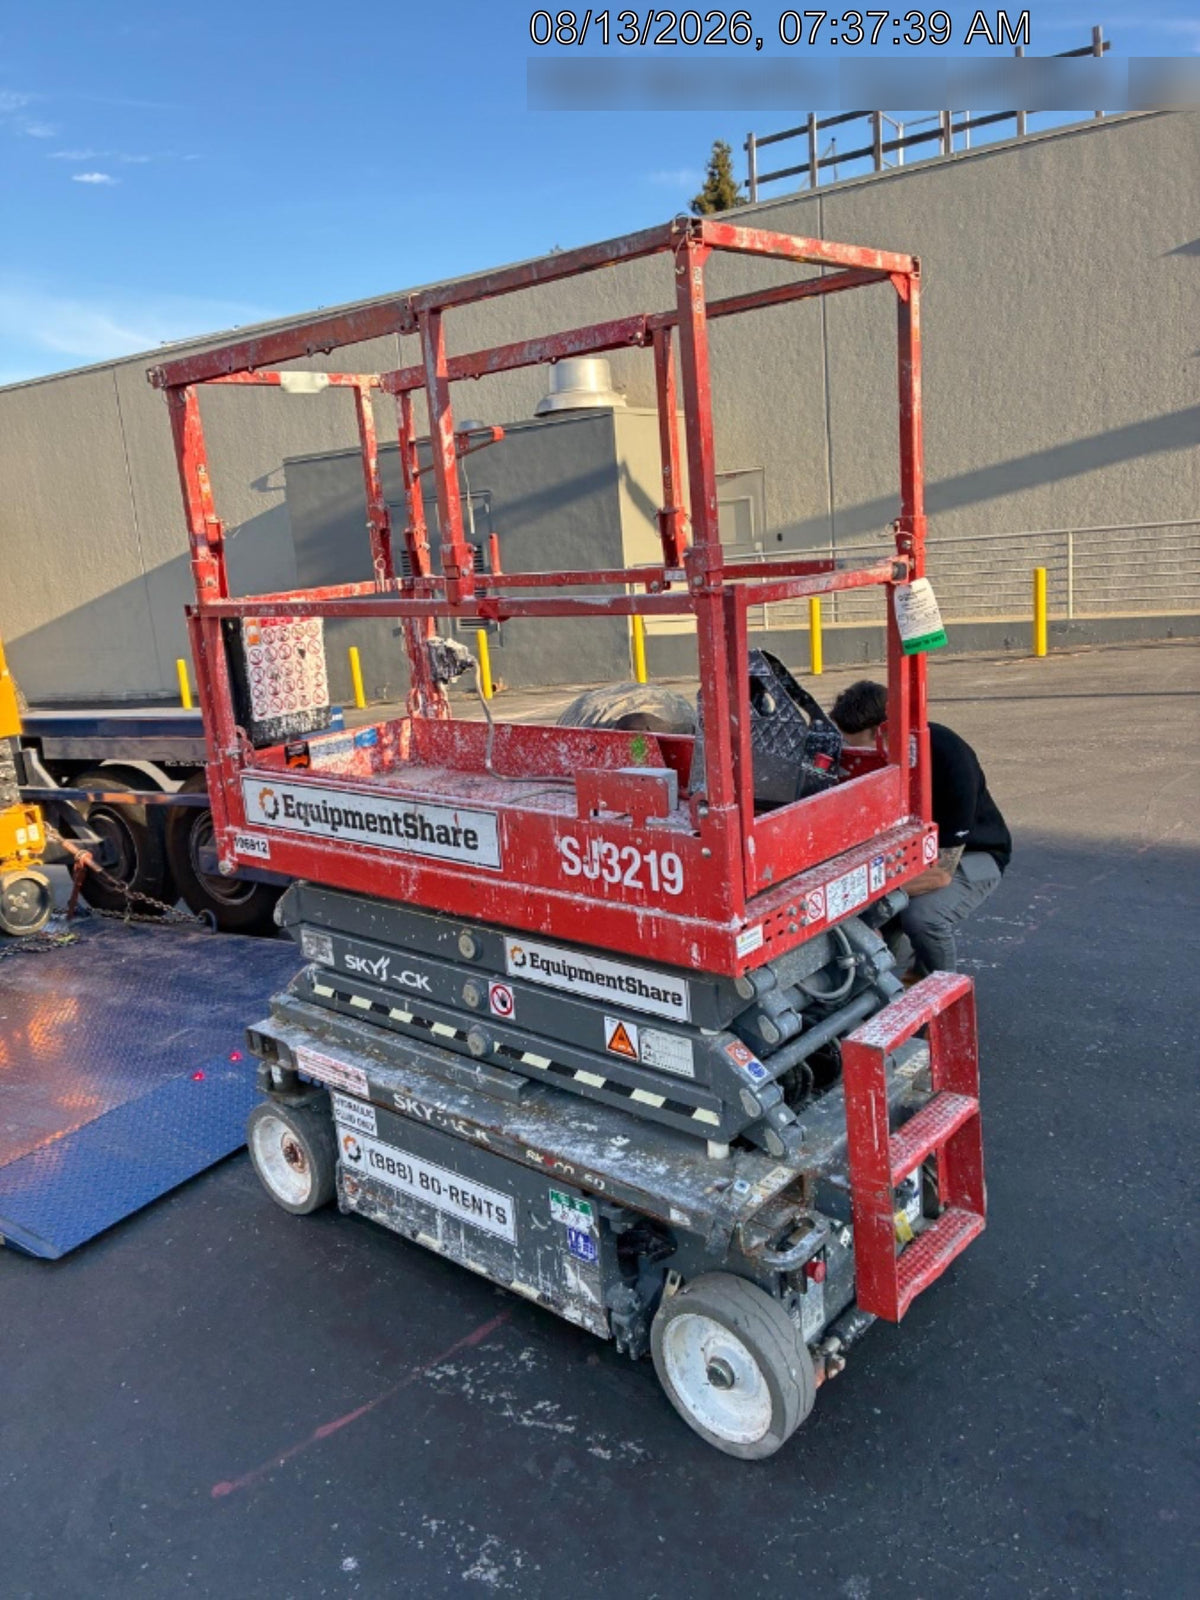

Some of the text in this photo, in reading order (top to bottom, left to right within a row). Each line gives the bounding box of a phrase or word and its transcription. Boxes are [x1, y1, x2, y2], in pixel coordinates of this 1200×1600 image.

[282, 794, 479, 851] EquipmentShare
[559, 835, 684, 895] SJ3219
[344, 954, 433, 993] SKYJCK
[529, 952, 683, 1007] EquipmentShare
[369, 1149, 413, 1185] (888)
[419, 1170, 507, 1226] 80-RENTS
